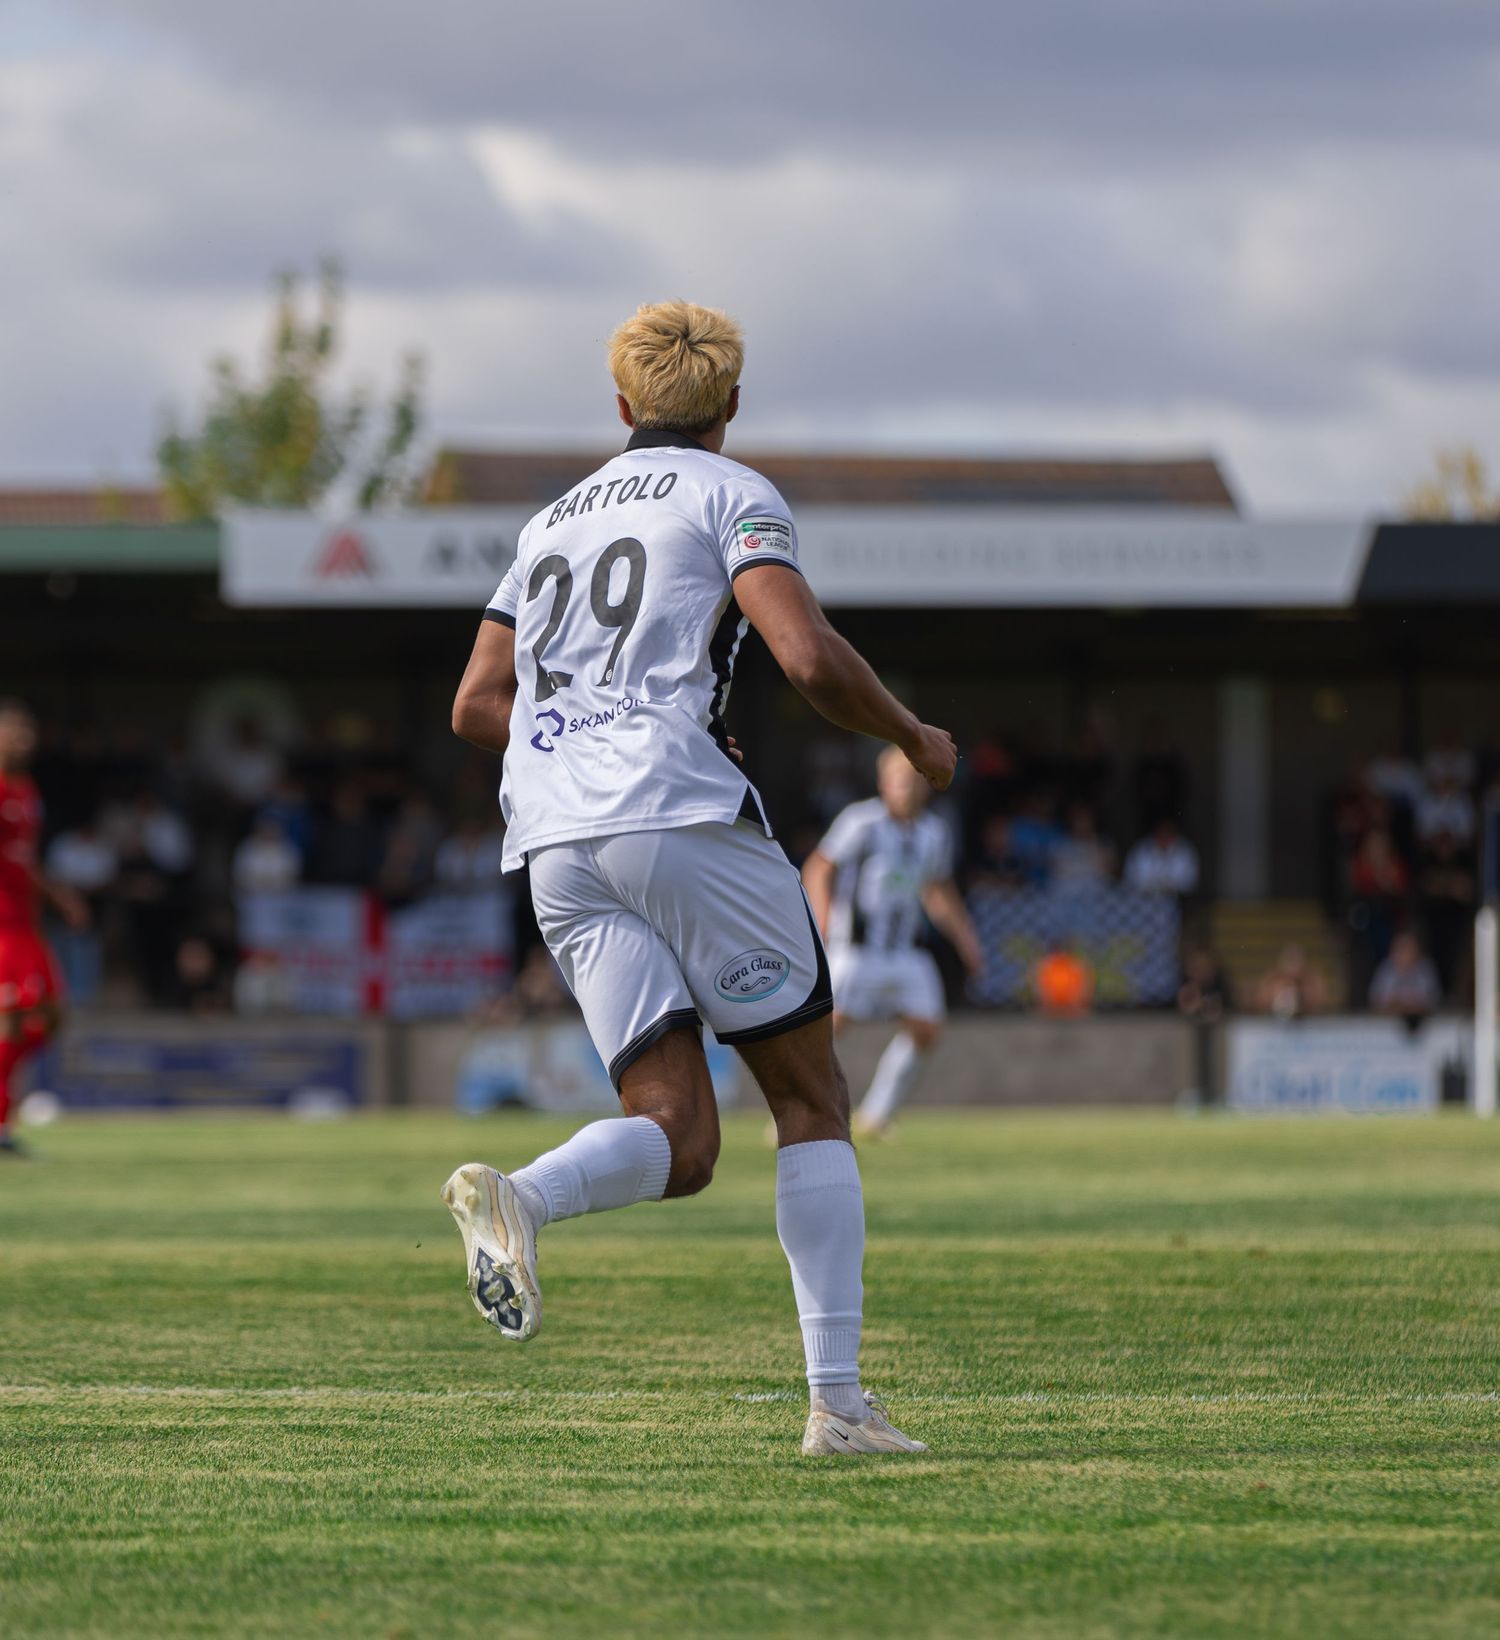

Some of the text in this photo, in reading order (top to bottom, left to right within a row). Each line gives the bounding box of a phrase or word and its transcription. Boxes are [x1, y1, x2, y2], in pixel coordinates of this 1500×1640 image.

[546, 472, 678, 529] BARTOLO
[526, 537, 647, 702] 29
[720, 957, 782, 990] Cara Glass
